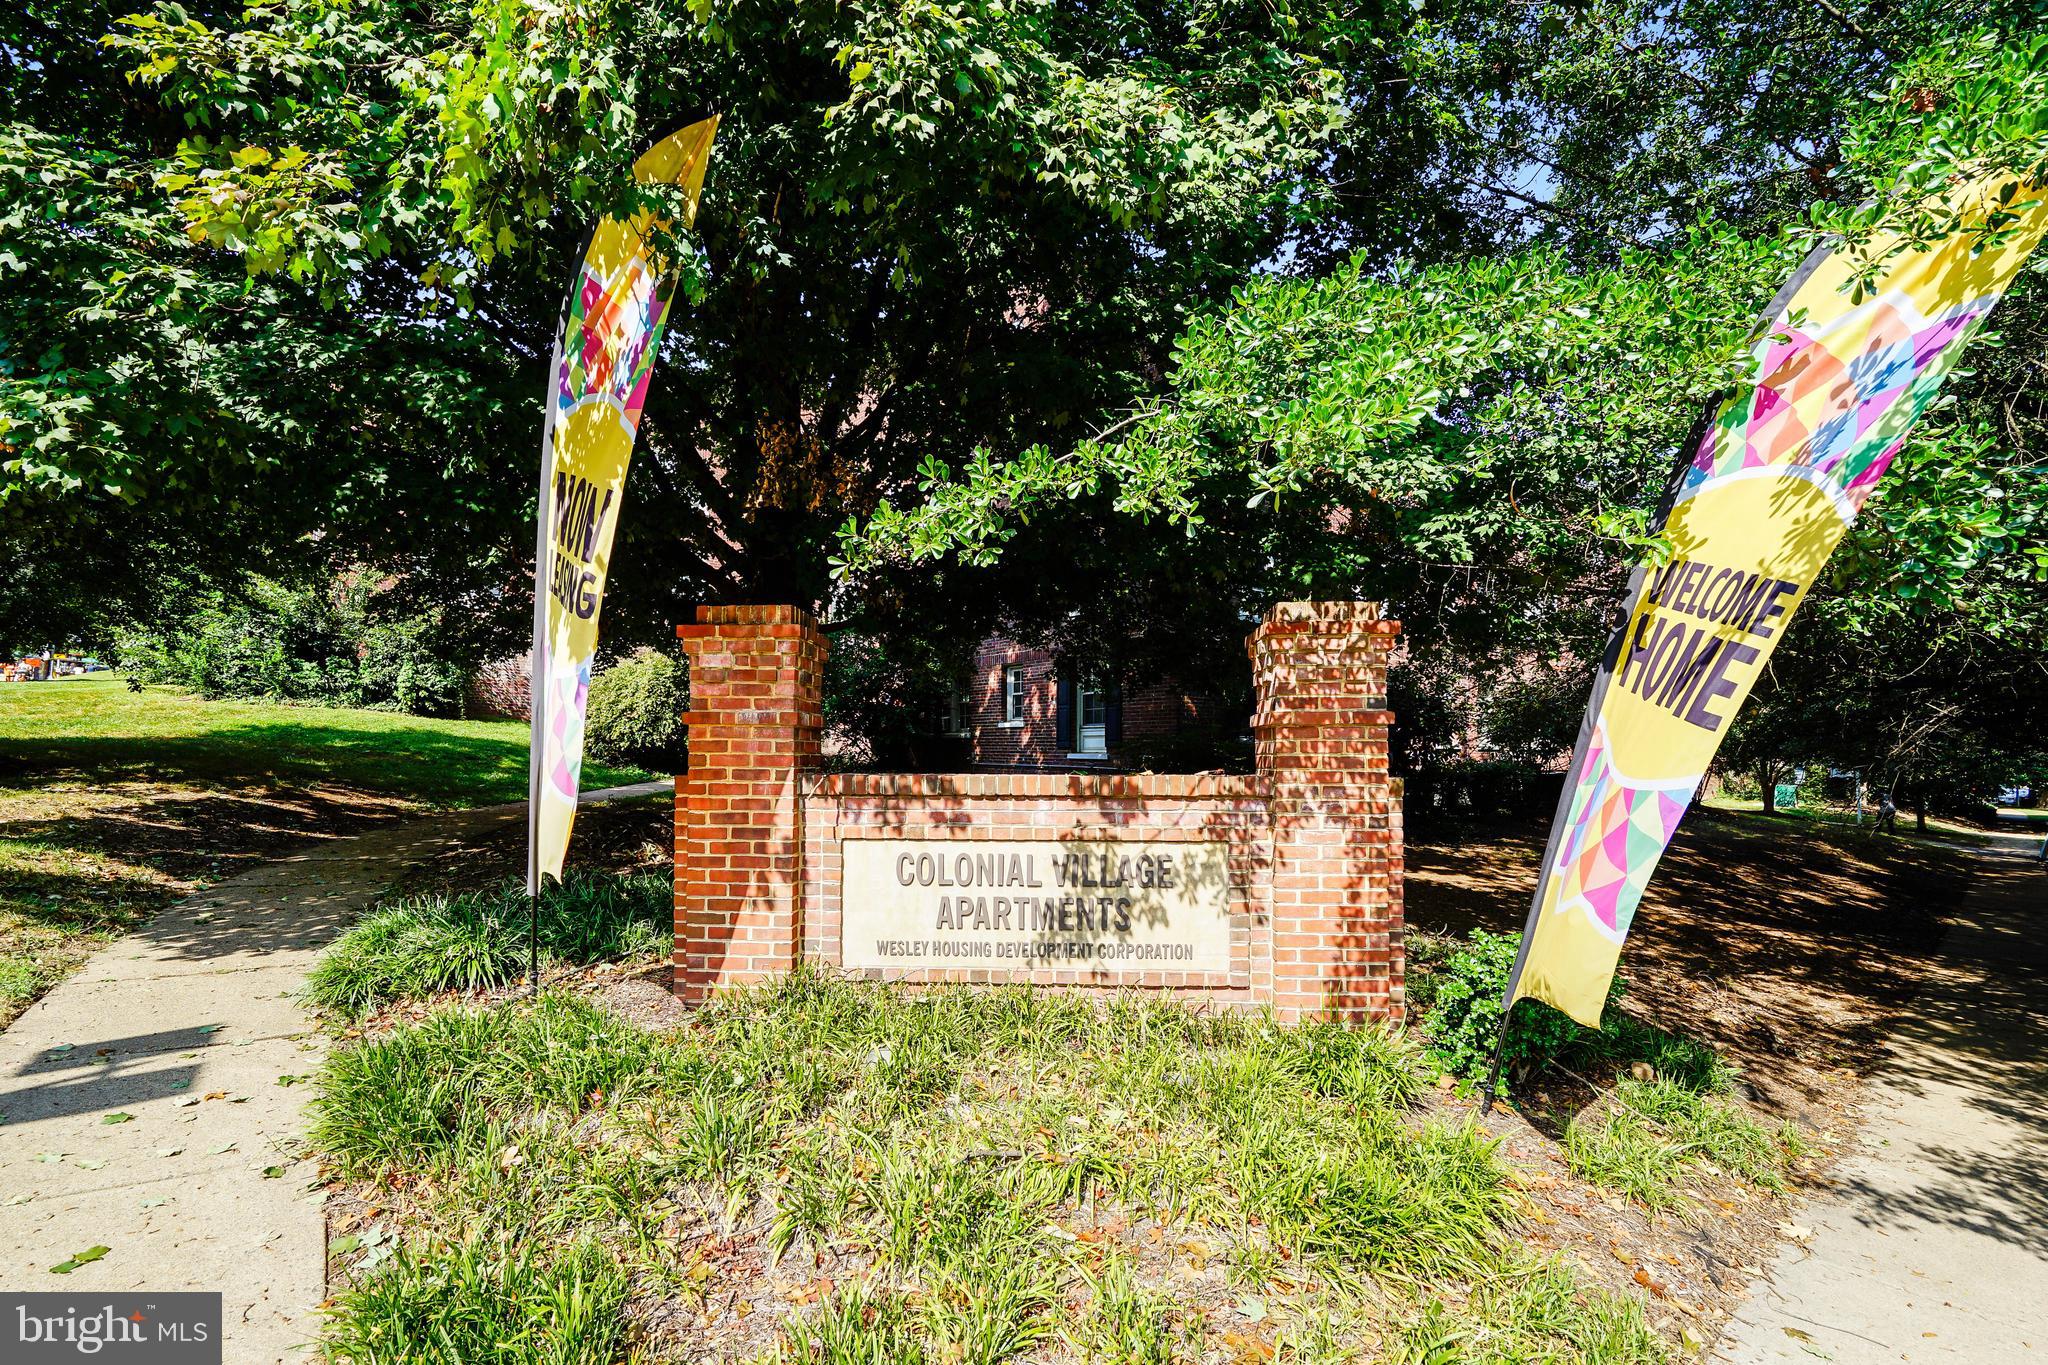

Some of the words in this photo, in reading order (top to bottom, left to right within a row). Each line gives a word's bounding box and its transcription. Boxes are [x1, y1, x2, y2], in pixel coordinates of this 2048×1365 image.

[552, 471, 614, 563] NOW
[1647, 559, 1800, 639] WELCOME
[1619, 613, 1761, 732] HOME
[895, 851, 1042, 888] COLONIAL
[1051, 853, 1174, 889] VILLAGE
[935, 895, 1132, 932] APARTMENTS
[876, 940, 930, 957] WESLEY
[932, 941, 992, 958] HOUSING
[995, 941, 1094, 959] DEVELOPMENT
[1097, 943, 1194, 960] CORPORATION
